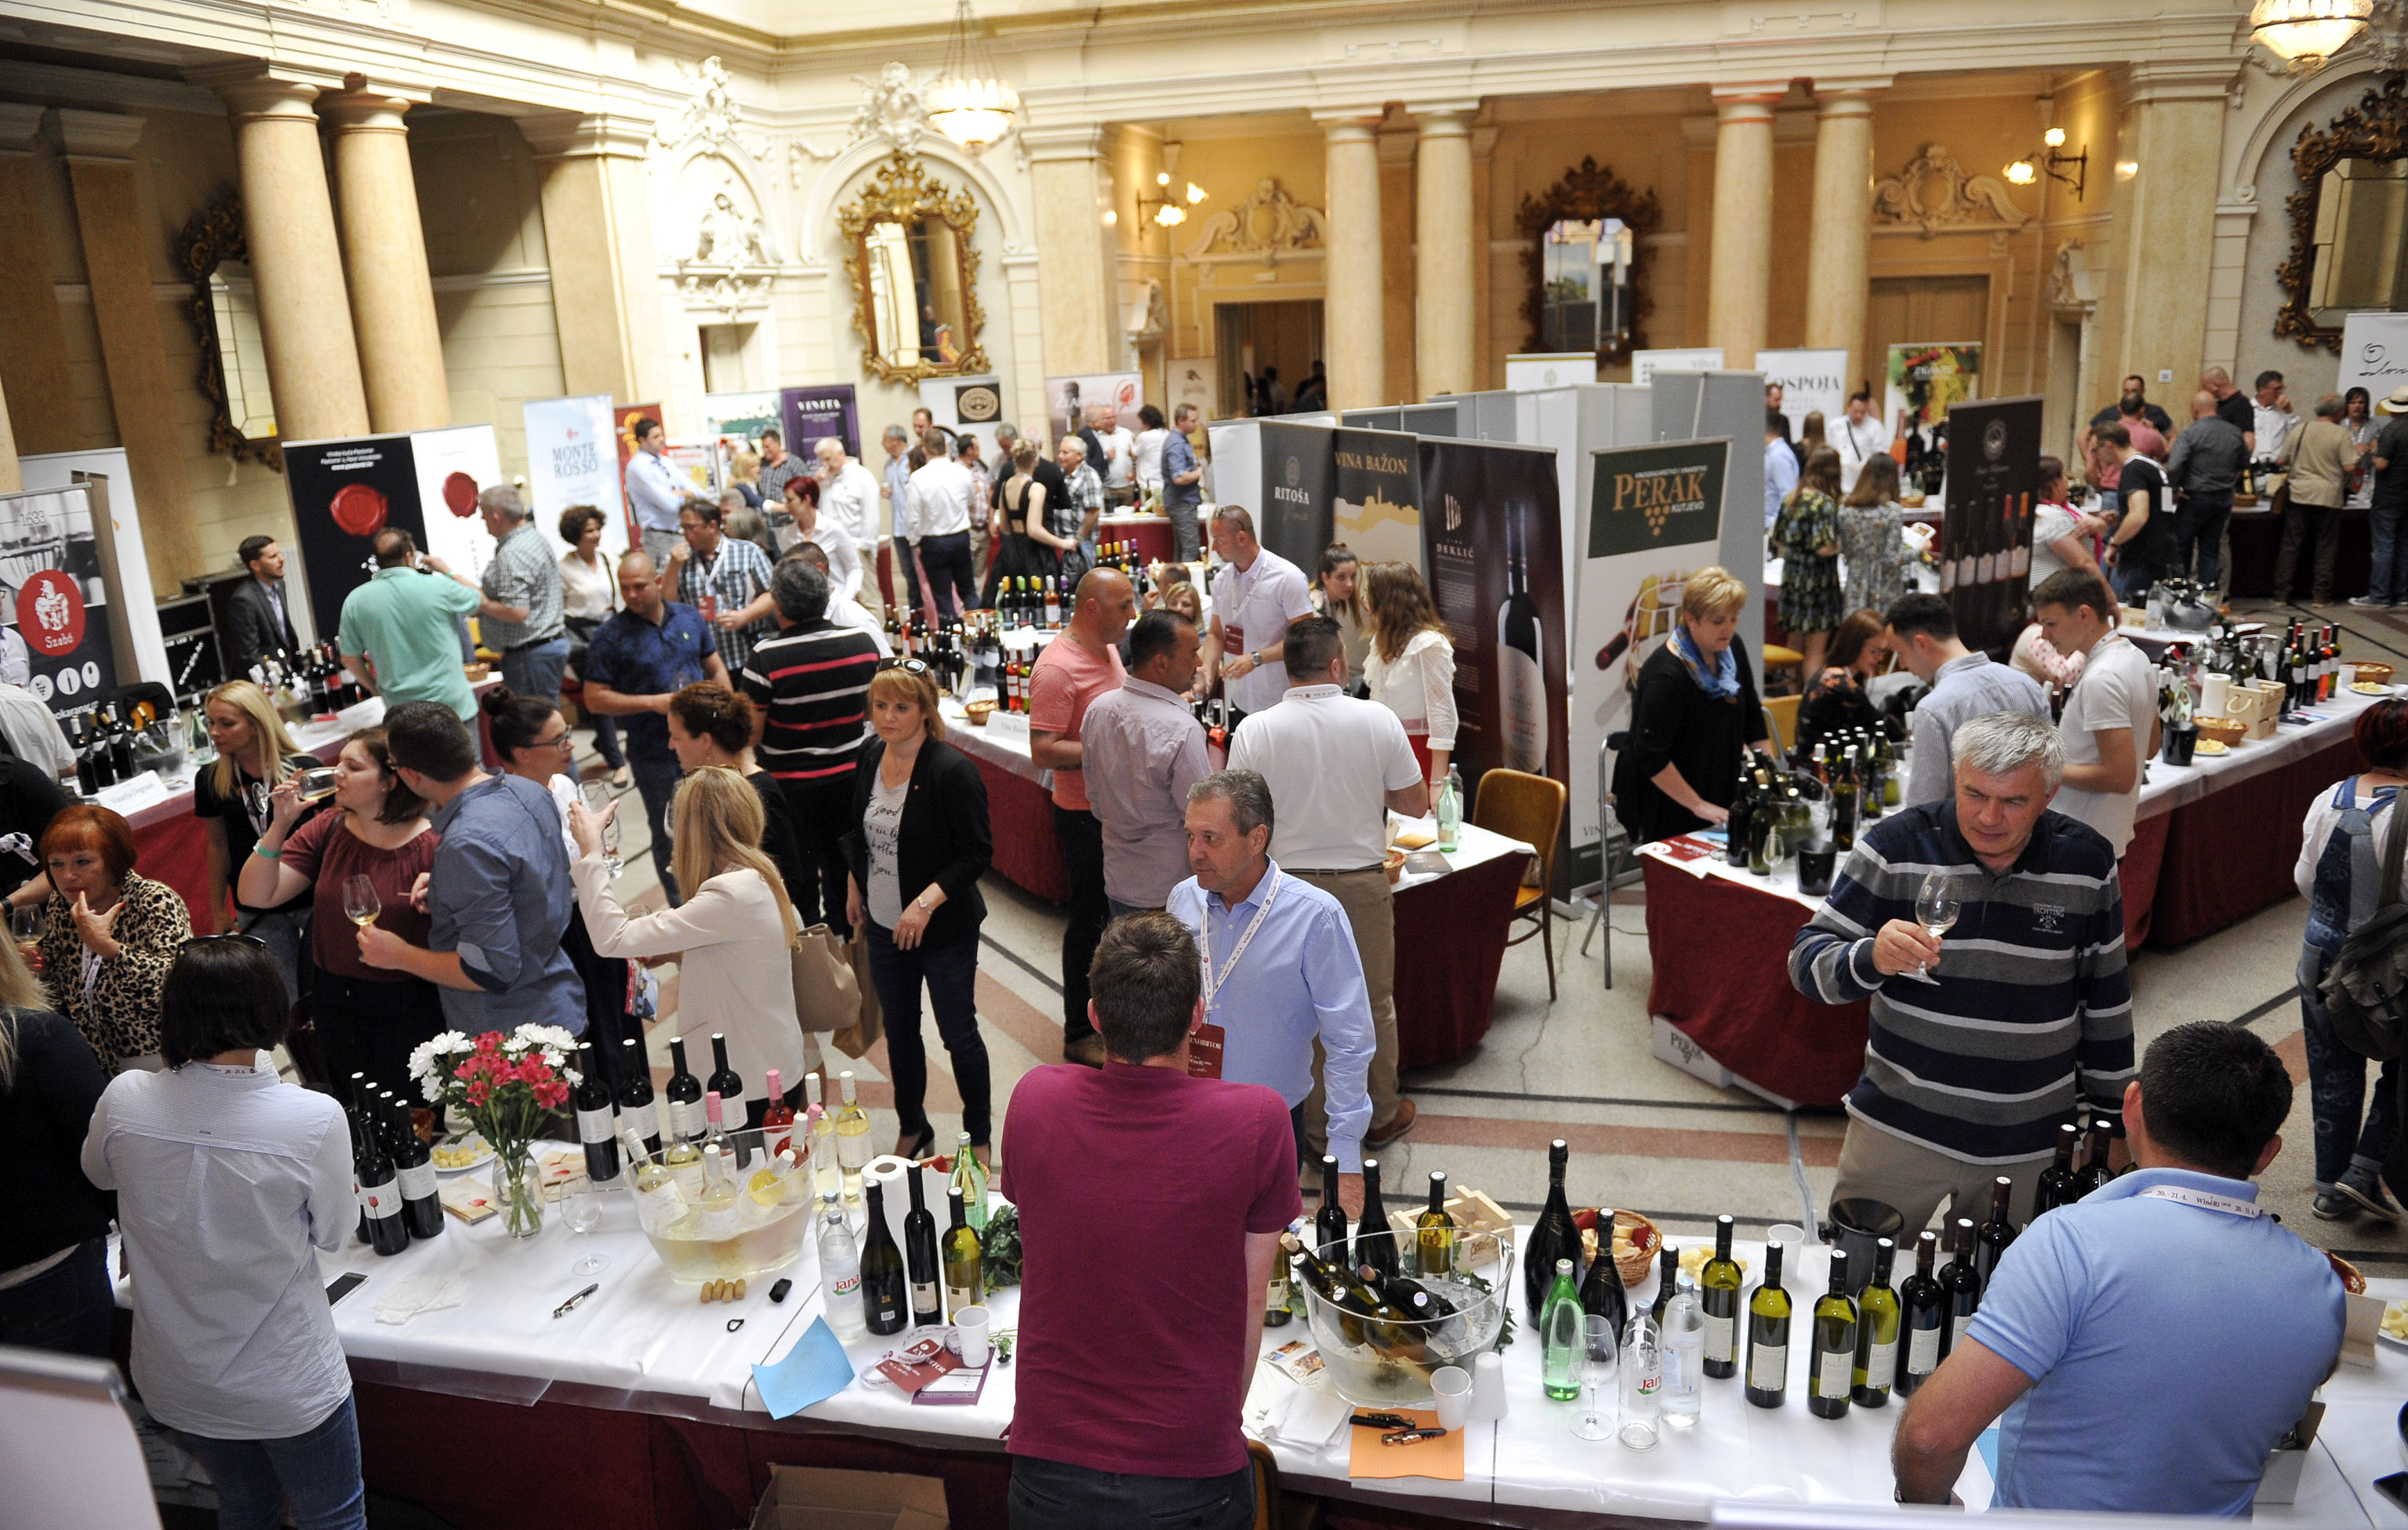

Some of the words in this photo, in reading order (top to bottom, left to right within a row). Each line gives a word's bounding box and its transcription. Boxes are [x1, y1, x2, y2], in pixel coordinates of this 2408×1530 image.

[553, 442, 596, 463] MONTE
[554, 457, 598, 479] ROSSO
[1335, 451, 1363, 470] VINA
[1366, 453, 1408, 474] BAŽON
[1274, 486, 1310, 505] RITOŠA
[1612, 471, 1706, 512] PERAK
[1671, 500, 1705, 513] KUTJEVO
[1436, 543, 1475, 558] DEKLIĆ
[45, 633, 74, 649] Szabó
[1189, 1037, 1222, 1050] EXHIBITOR
[835, 1274, 860, 1292] Jana
[1641, 1375, 1662, 1391] Jan
